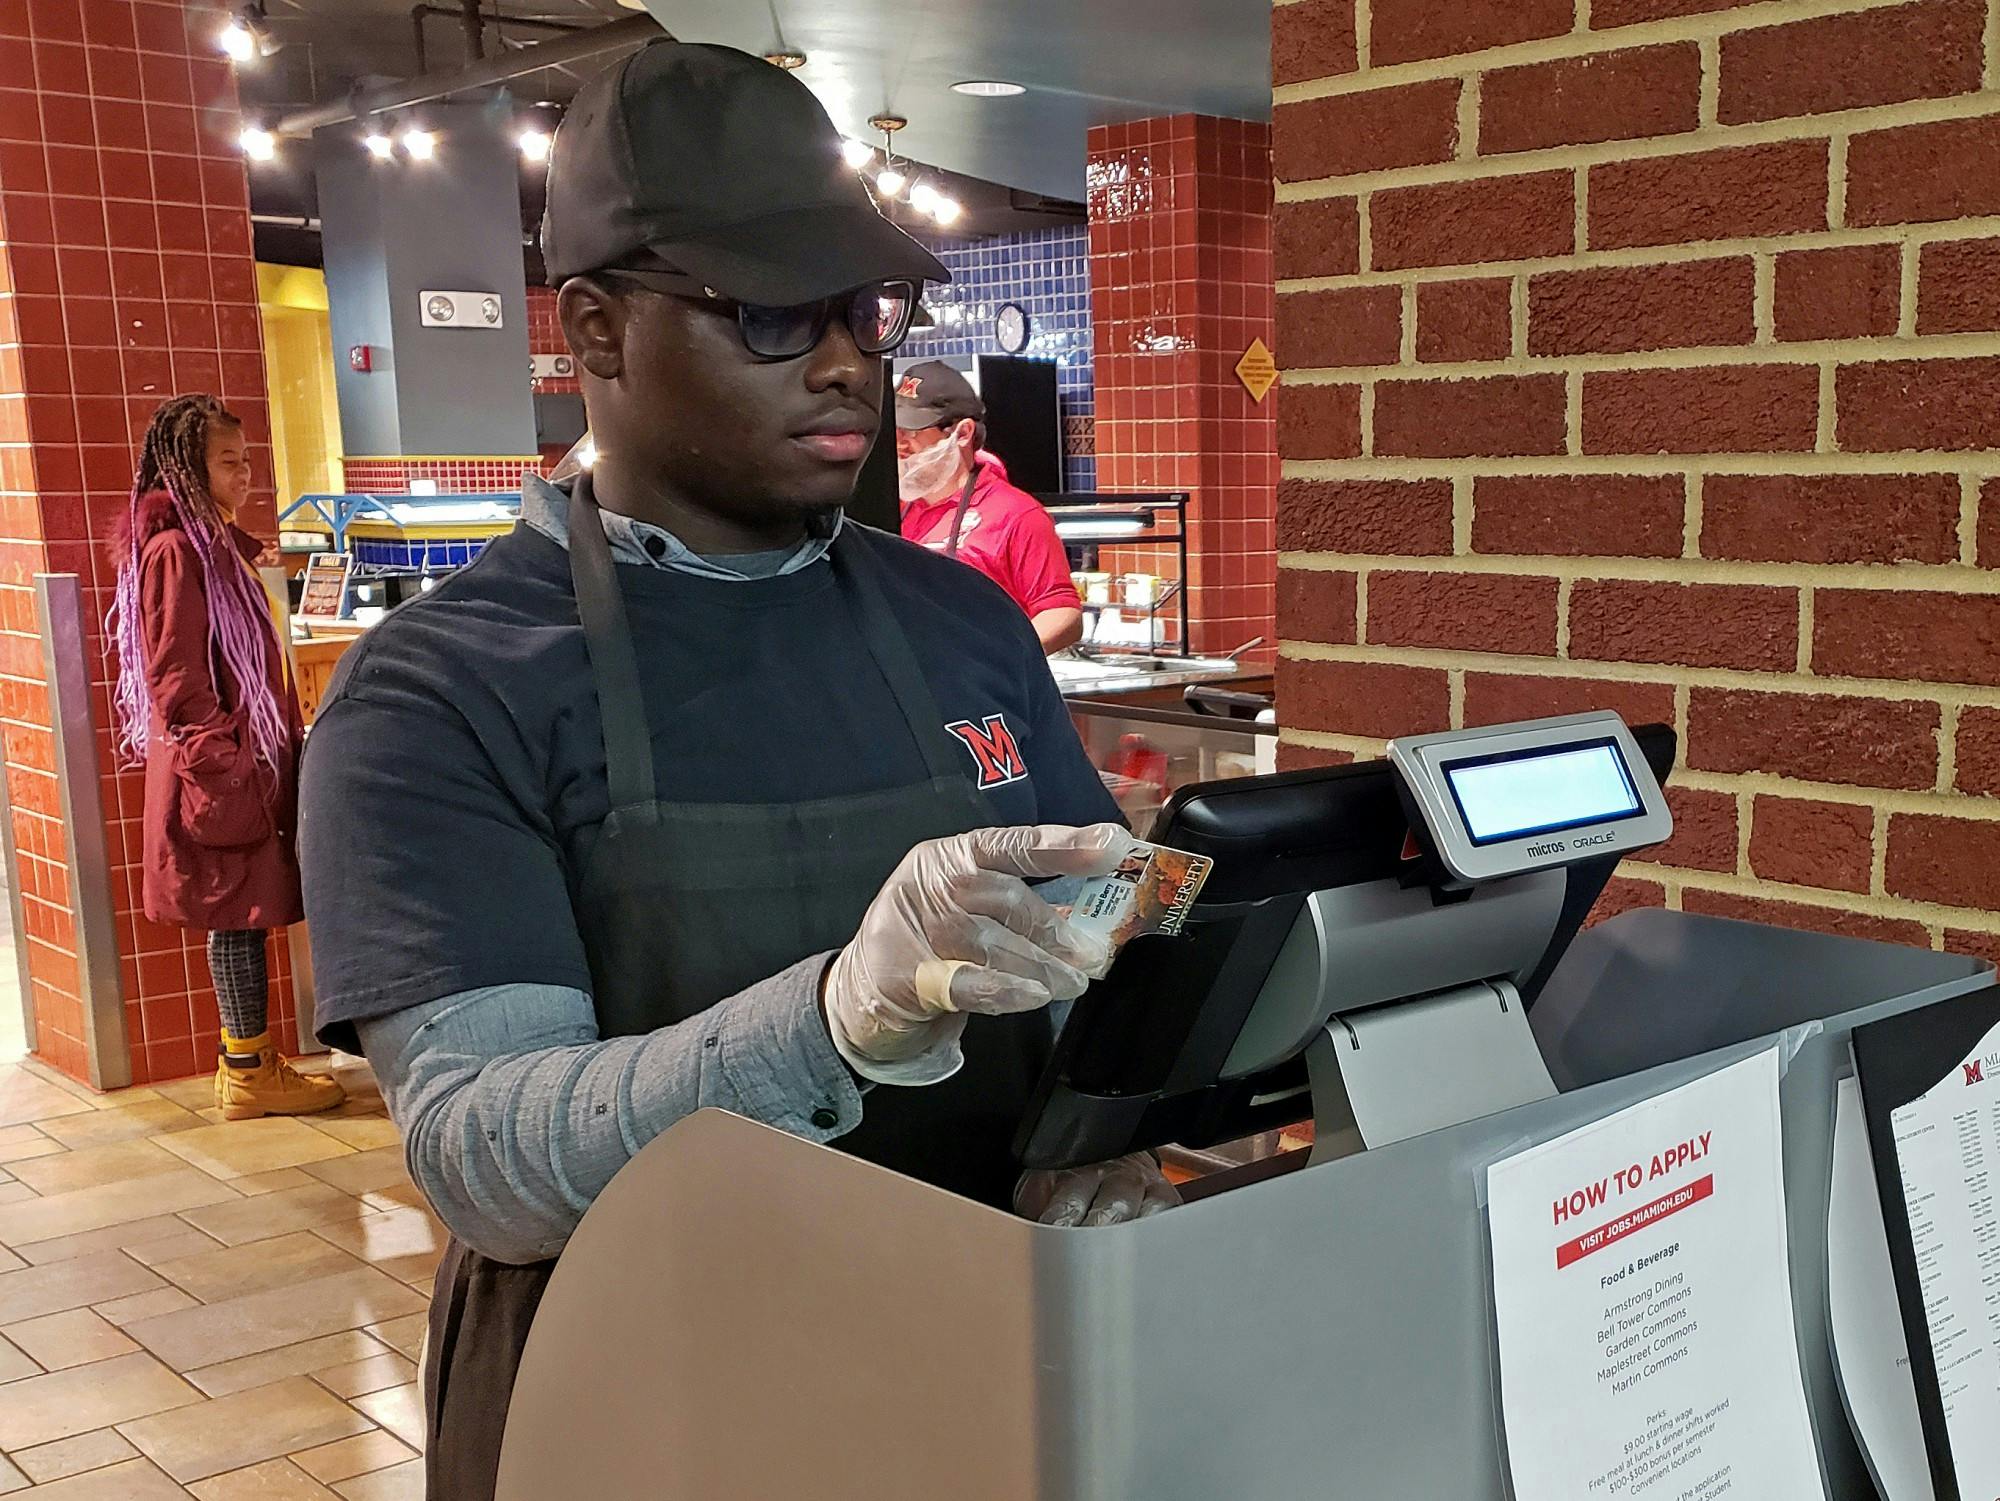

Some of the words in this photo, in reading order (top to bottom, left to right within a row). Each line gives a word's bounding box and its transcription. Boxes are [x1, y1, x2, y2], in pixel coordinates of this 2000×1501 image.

[944, 713, 1028, 790] M
[1526, 841, 1565, 858] micros
[1159, 859, 1206, 935] UNIVERSITY
[1962, 1059, 1984, 1086] M
[1553, 1178, 1608, 1225] HOW
[1613, 1164, 1643, 1195] TO
[1649, 1130, 1712, 1181] APPLY
[1579, 1230, 1605, 1251] VISIT
[1606, 1188, 1693, 1239] JOBS.MIAMIOH.EDU
[1600, 1266, 1626, 1289] Food
[1628, 1263, 1635, 1275] &
[1637, 1242, 1680, 1271] Beverage
[1597, 1323, 1615, 1344] Bell
[1617, 1311, 1645, 1333] Tower
[1647, 1285, 1692, 1317] Commons
[1603, 1288, 1653, 1321] Armstrong
[1655, 1271, 1684, 1294] Dining
[1597, 1345, 1651, 1383] Maplestreet
[1653, 1320, 1698, 1352] Commons
[1605, 1333, 1640, 1358] Garden
[1642, 1307, 1687, 1338] Commons
[1612, 1372, 1642, 1396] Martin
[1643, 1346, 1689, 1377] Commons
[1588, 1475, 1606, 1491] Free
[1607, 1463, 1625, 1480] meal
[1626, 1457, 1634, 1468] at
[1635, 1445, 1655, 1463] lunch
[1655, 1440, 1662, 1450] &
[1662, 1427, 1684, 1447] dinner
[1685, 1414, 1704, 1432] shifts
[1704, 1398, 1730, 1420] worked
[1646, 1420, 1674, 1441] starting
[1675, 1407, 1693, 1424] wage
[1609, 1462, 1649, 1494] $100-$300
[1649, 1450, 1672, 1469] bonus
[1672, 1441, 1685, 1457] per
[1685, 1421, 1717, 1447] semester
[1630, 1464, 1671, 1495] Convenient
[1671, 1445, 1702, 1470] locations
[1682, 1489, 1694, 1501] the
[1694, 1465, 1732, 1493] application
[1704, 1479, 1732, 1501] Student
